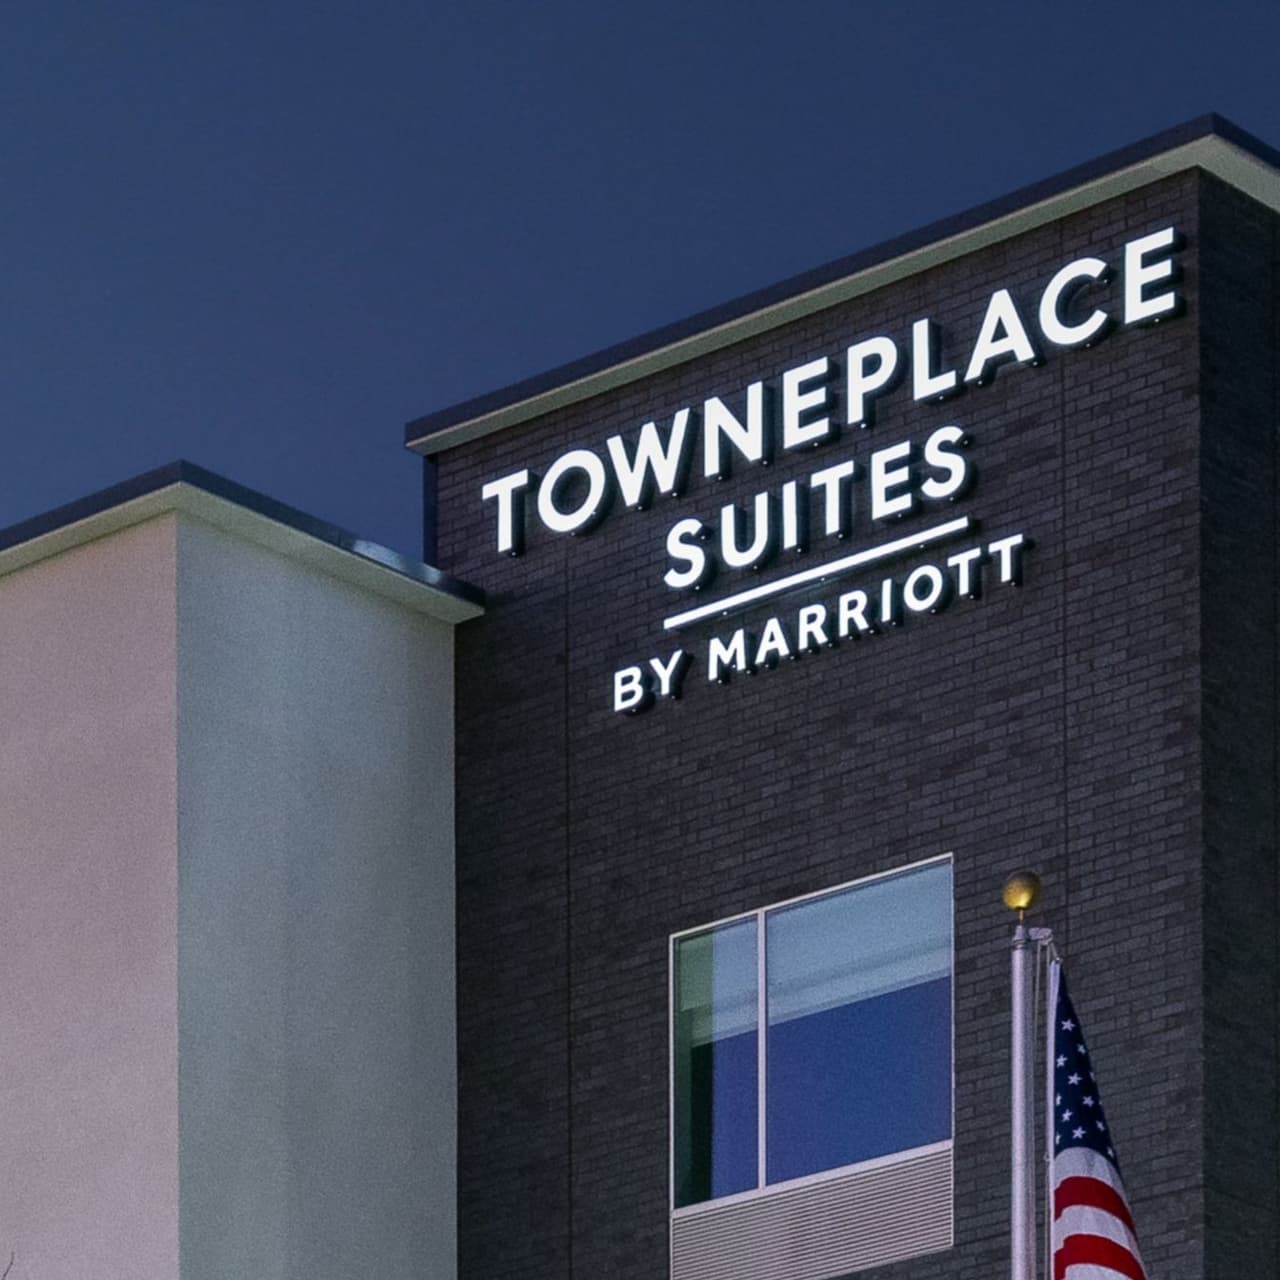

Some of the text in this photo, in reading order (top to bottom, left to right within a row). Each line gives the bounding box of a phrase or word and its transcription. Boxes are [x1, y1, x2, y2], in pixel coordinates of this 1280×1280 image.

[482, 227, 1177, 553] TOWNEPLACE
[662, 425, 968, 590] SUITES
[613, 533, 1024, 713] BY MARRIOTT
